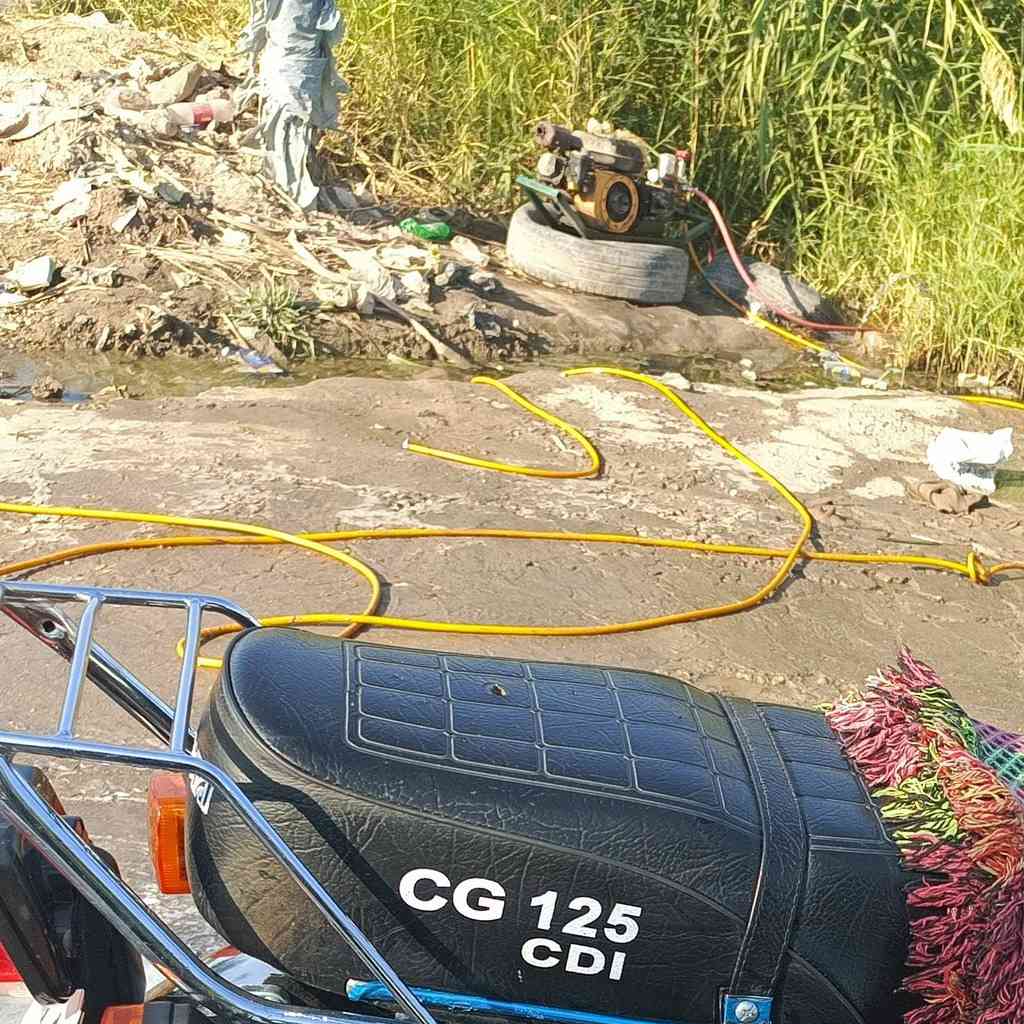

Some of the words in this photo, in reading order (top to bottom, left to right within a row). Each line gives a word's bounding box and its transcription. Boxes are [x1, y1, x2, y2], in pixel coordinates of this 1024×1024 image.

[399, 868, 506, 921] CG
[531, 890, 642, 943] 125
[521, 938, 626, 981] CDI
